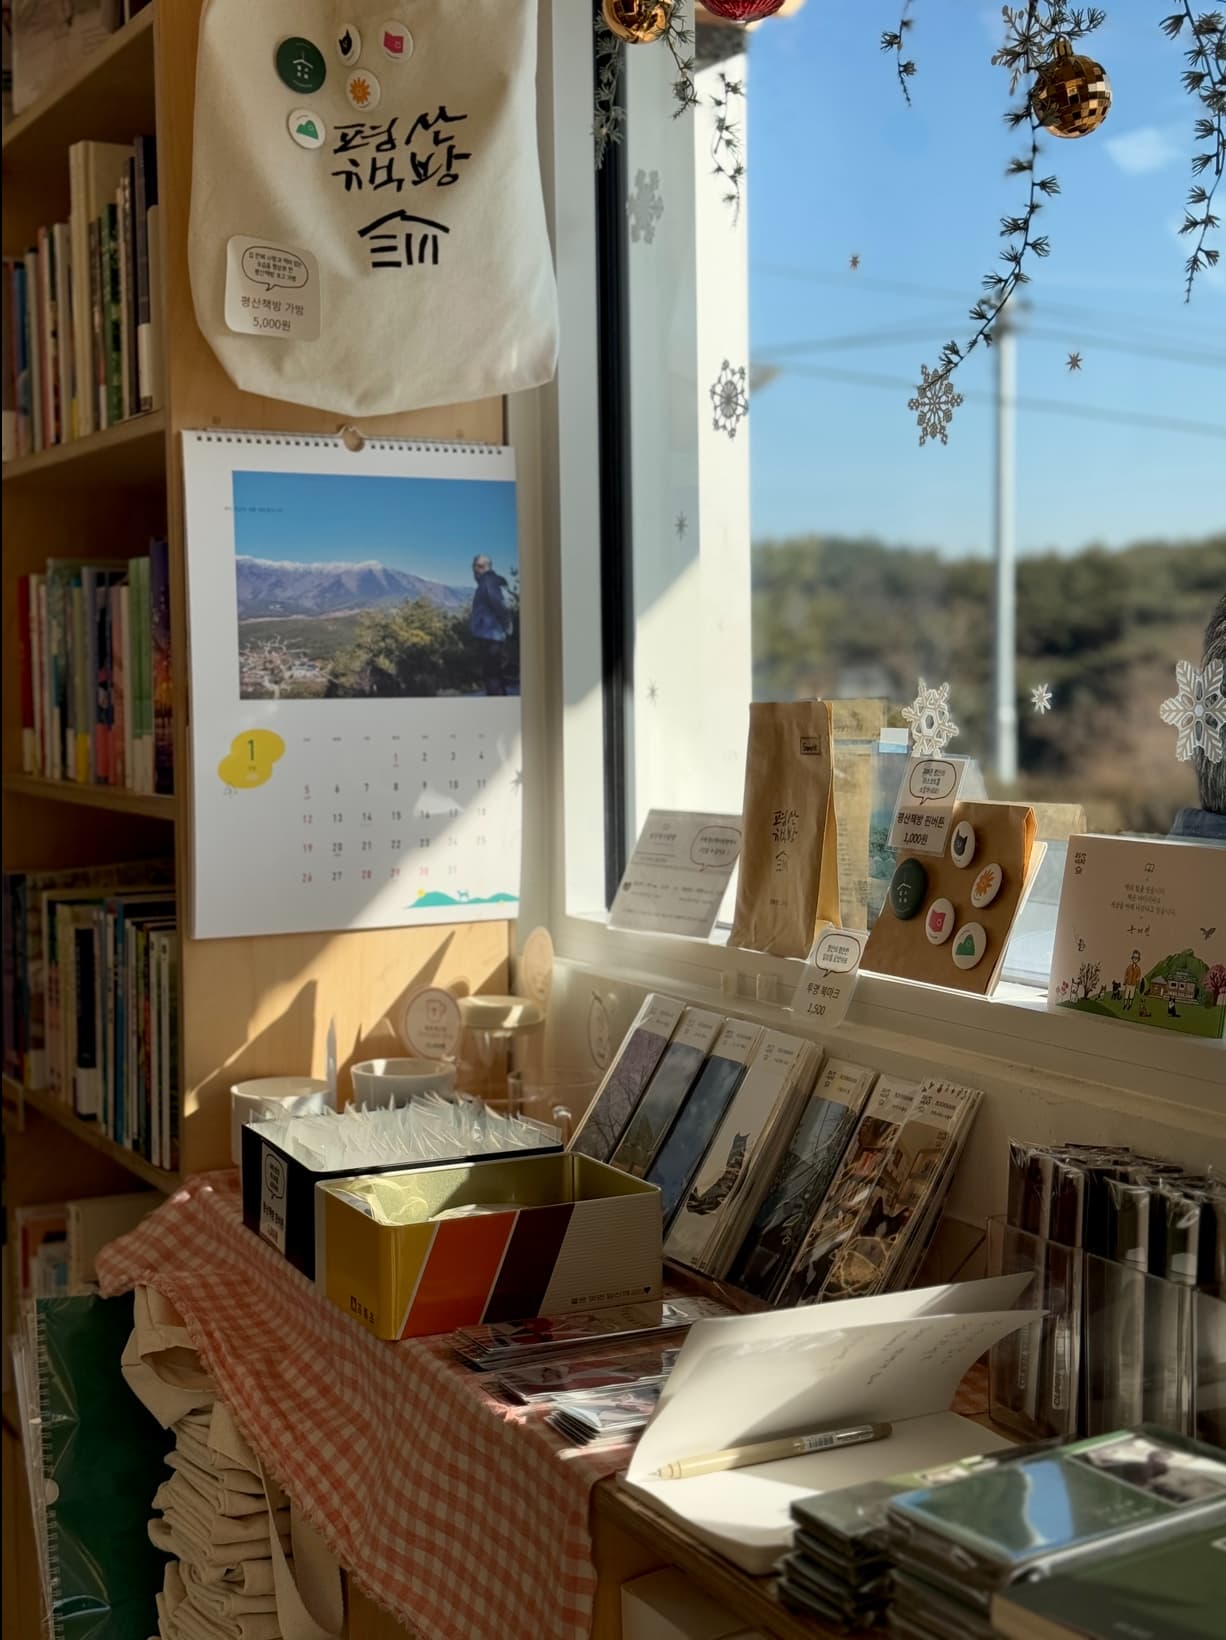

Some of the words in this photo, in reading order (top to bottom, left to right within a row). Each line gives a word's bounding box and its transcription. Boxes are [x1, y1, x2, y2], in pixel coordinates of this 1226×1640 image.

[333, 106, 467, 154] 평산
[331, 145, 472, 192] 책방
[241, 296, 282, 312] 평산책방
[285, 302, 304, 316] 가방
[253, 316, 291, 332] 5,000원
[247, 739, 254, 761] 1
[898, 812, 923, 826] 평산책방
[903, 832, 928, 845] 1,000원
[808, 982, 820, 996] 투명
[821, 985, 840, 999] 북마크
[807, 1003, 826, 1016] 1,500
